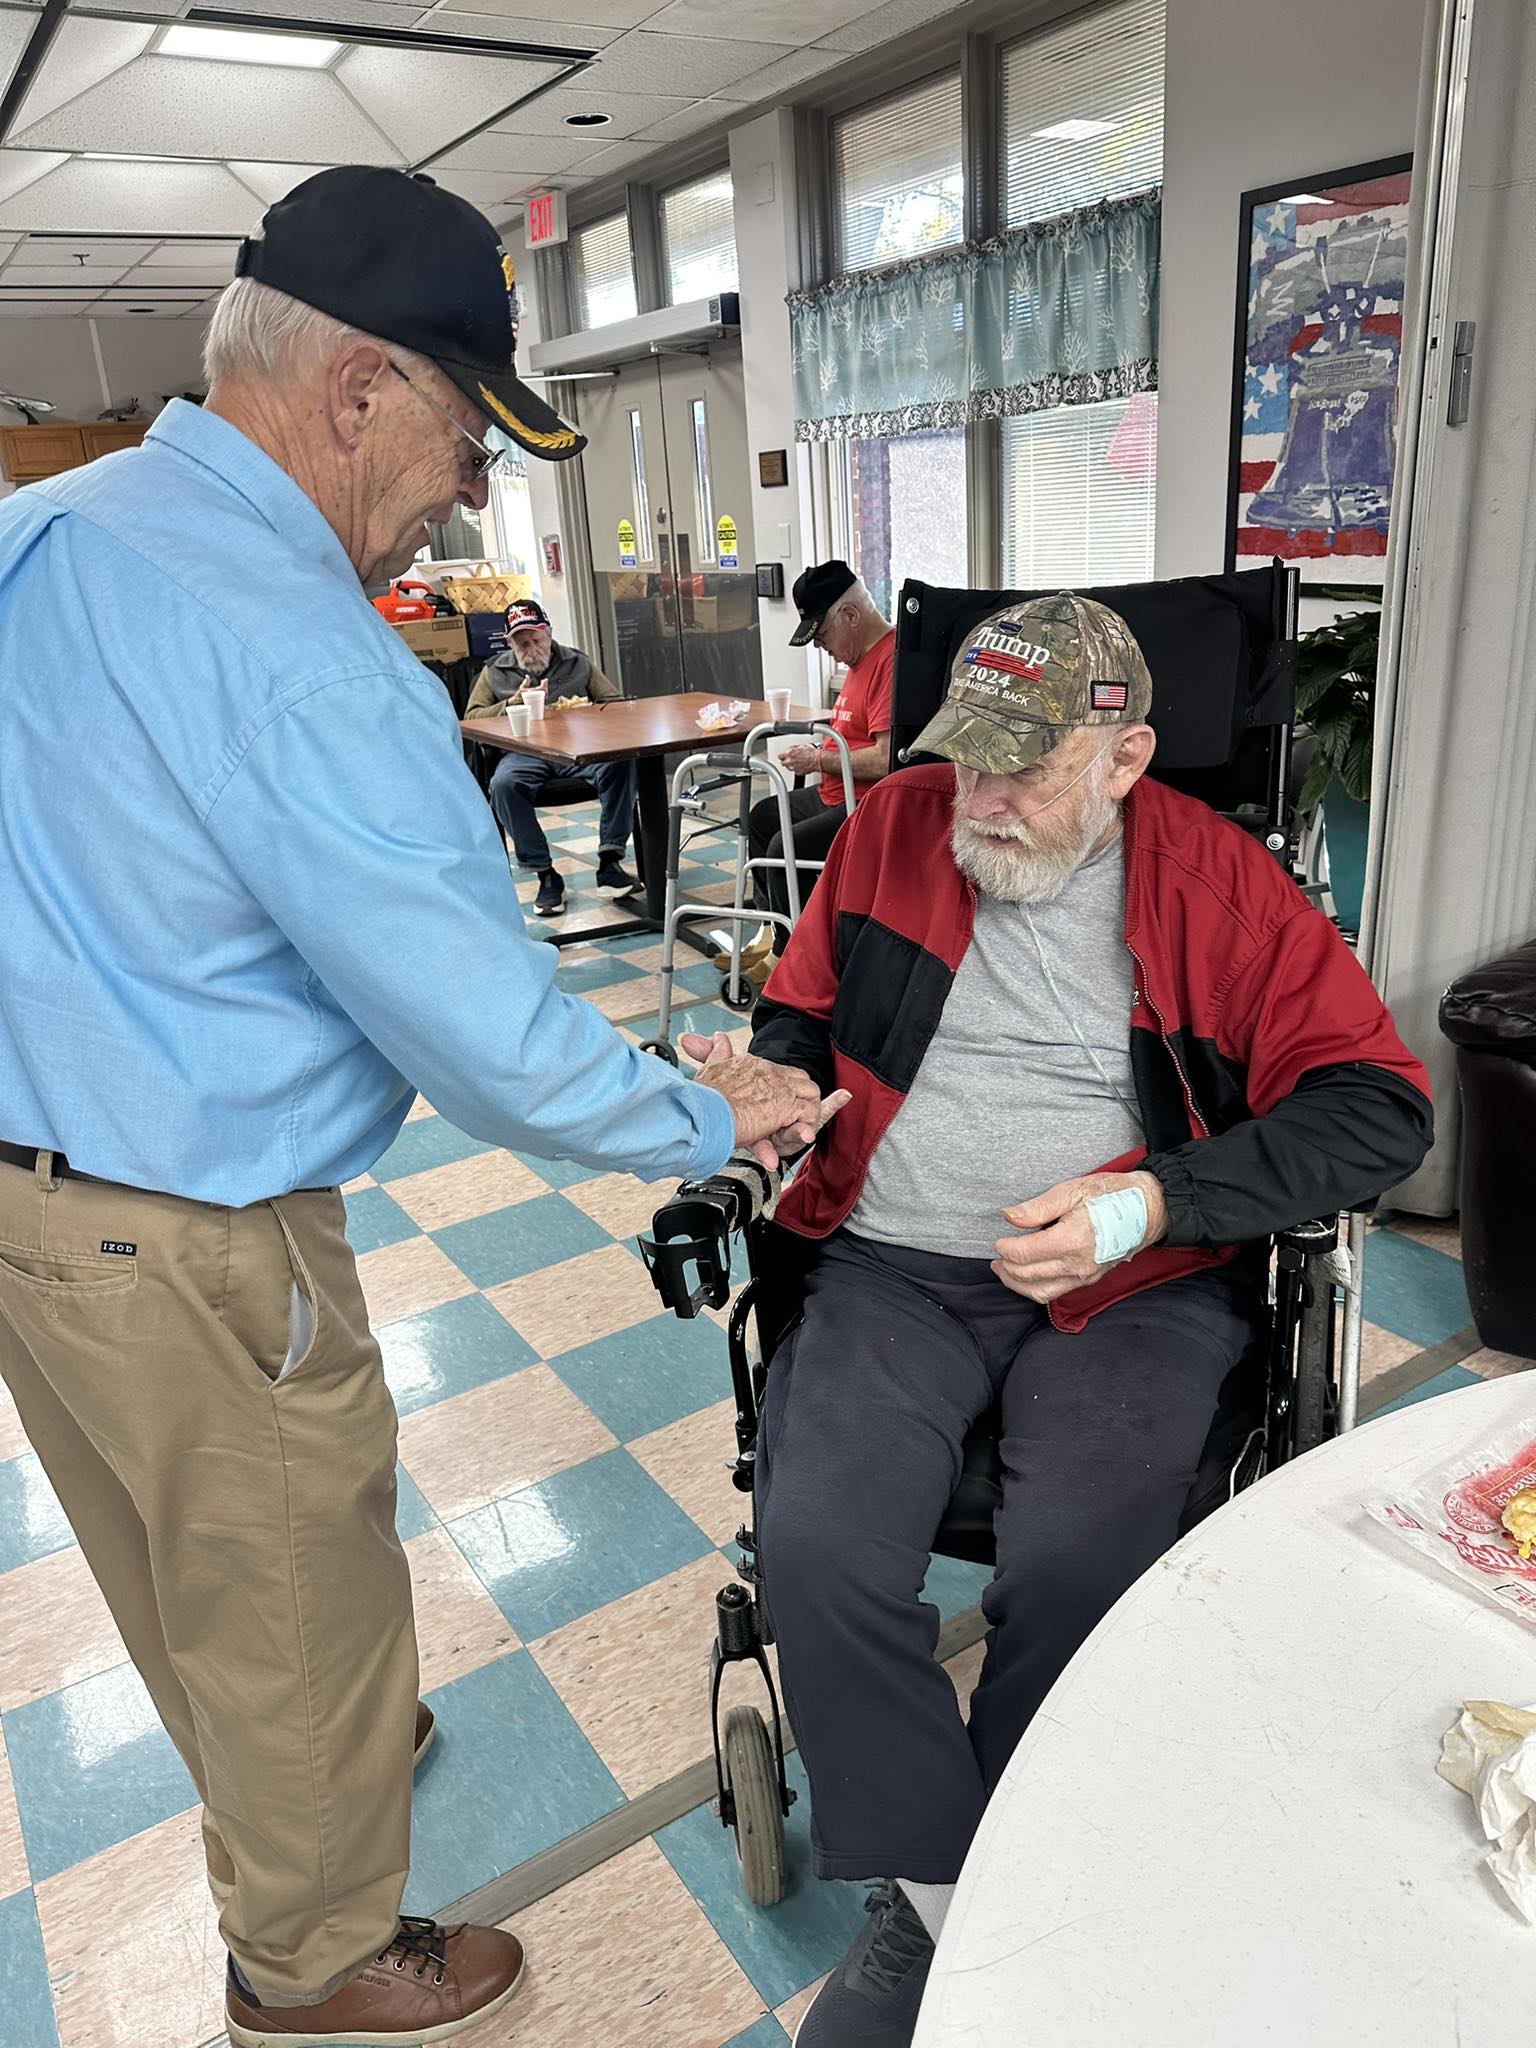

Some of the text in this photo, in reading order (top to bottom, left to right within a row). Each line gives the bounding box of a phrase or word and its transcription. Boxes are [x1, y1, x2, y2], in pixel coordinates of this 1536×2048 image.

[529, 194, 553, 241] EXIT
[966, 665, 1011, 688] 2024
[964, 679, 999, 696] AMERICA
[1001, 690, 1030, 706] BACK
[103, 1243, 133, 1253] IZOD
